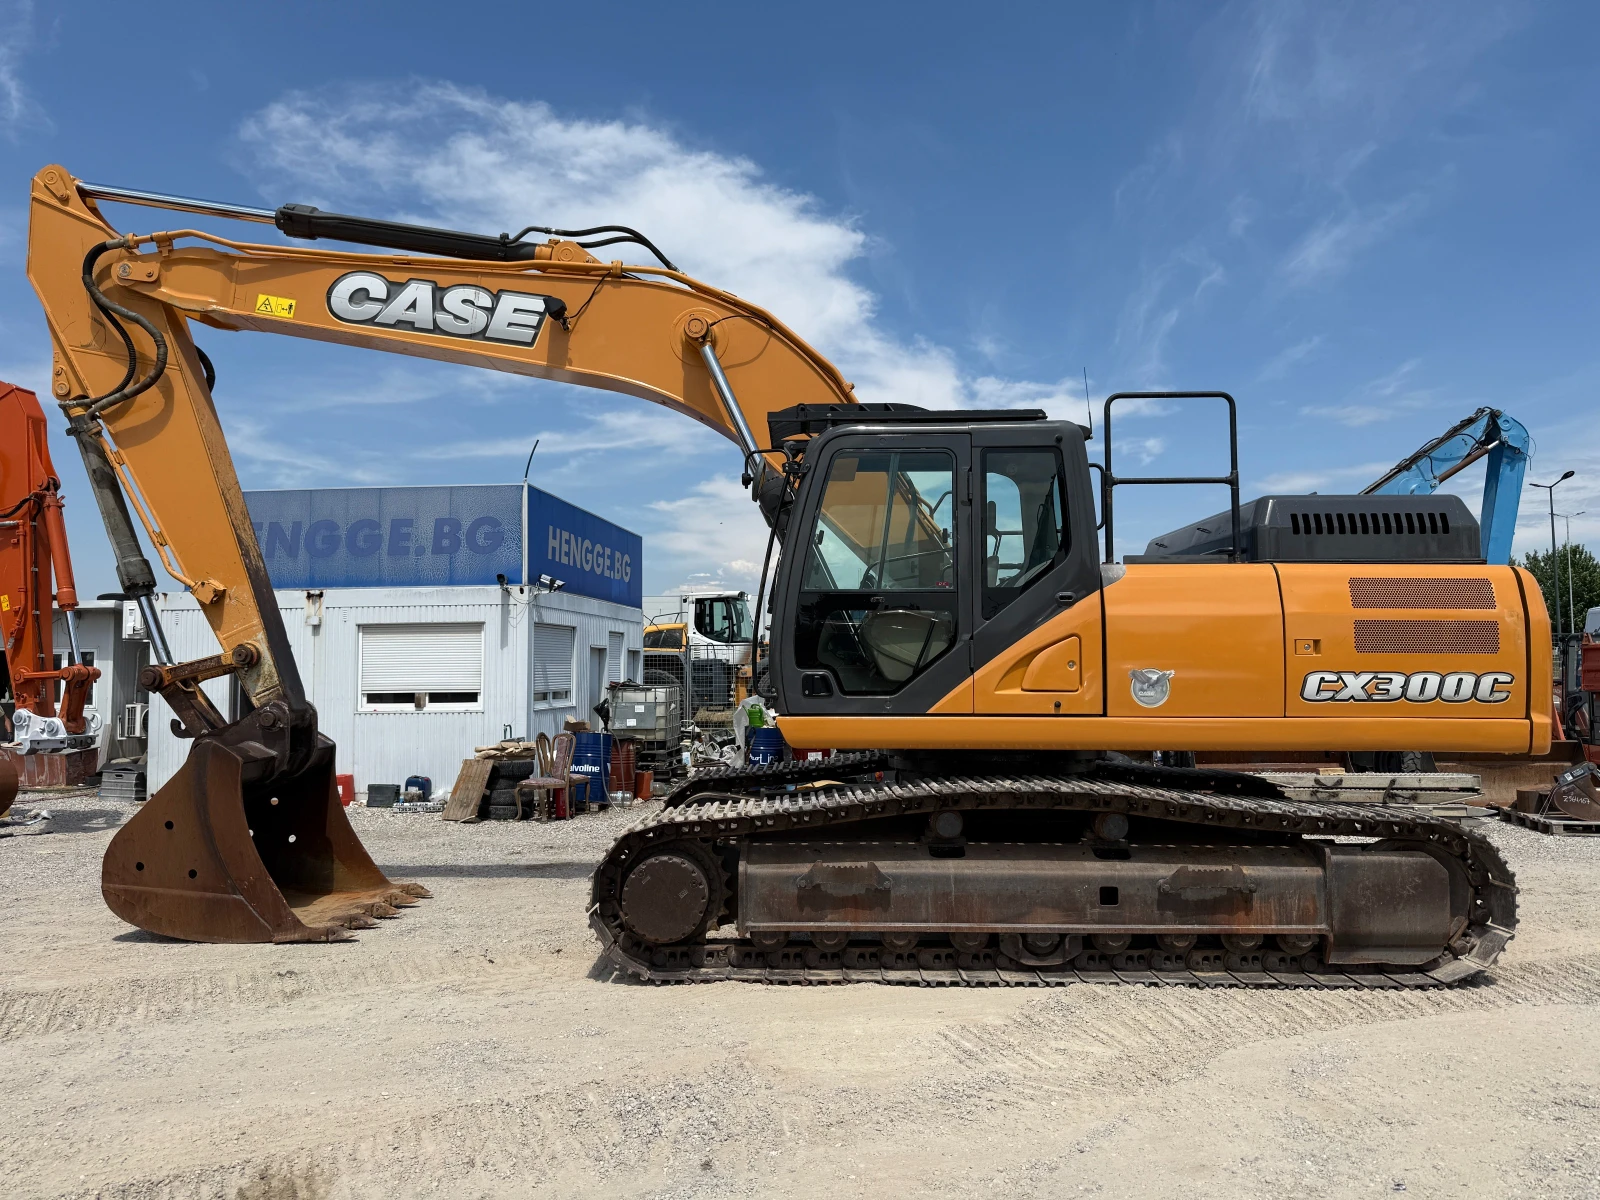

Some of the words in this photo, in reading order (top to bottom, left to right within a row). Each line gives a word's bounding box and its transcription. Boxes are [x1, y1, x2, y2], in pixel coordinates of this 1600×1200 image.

[328, 273, 549, 344] CASE
[252, 516, 505, 559] NGGE.BG
[547, 525, 632, 583] HENGGE.BG
[1302, 671, 1513, 702] CX300C
[570, 764, 601, 773] alvoline
